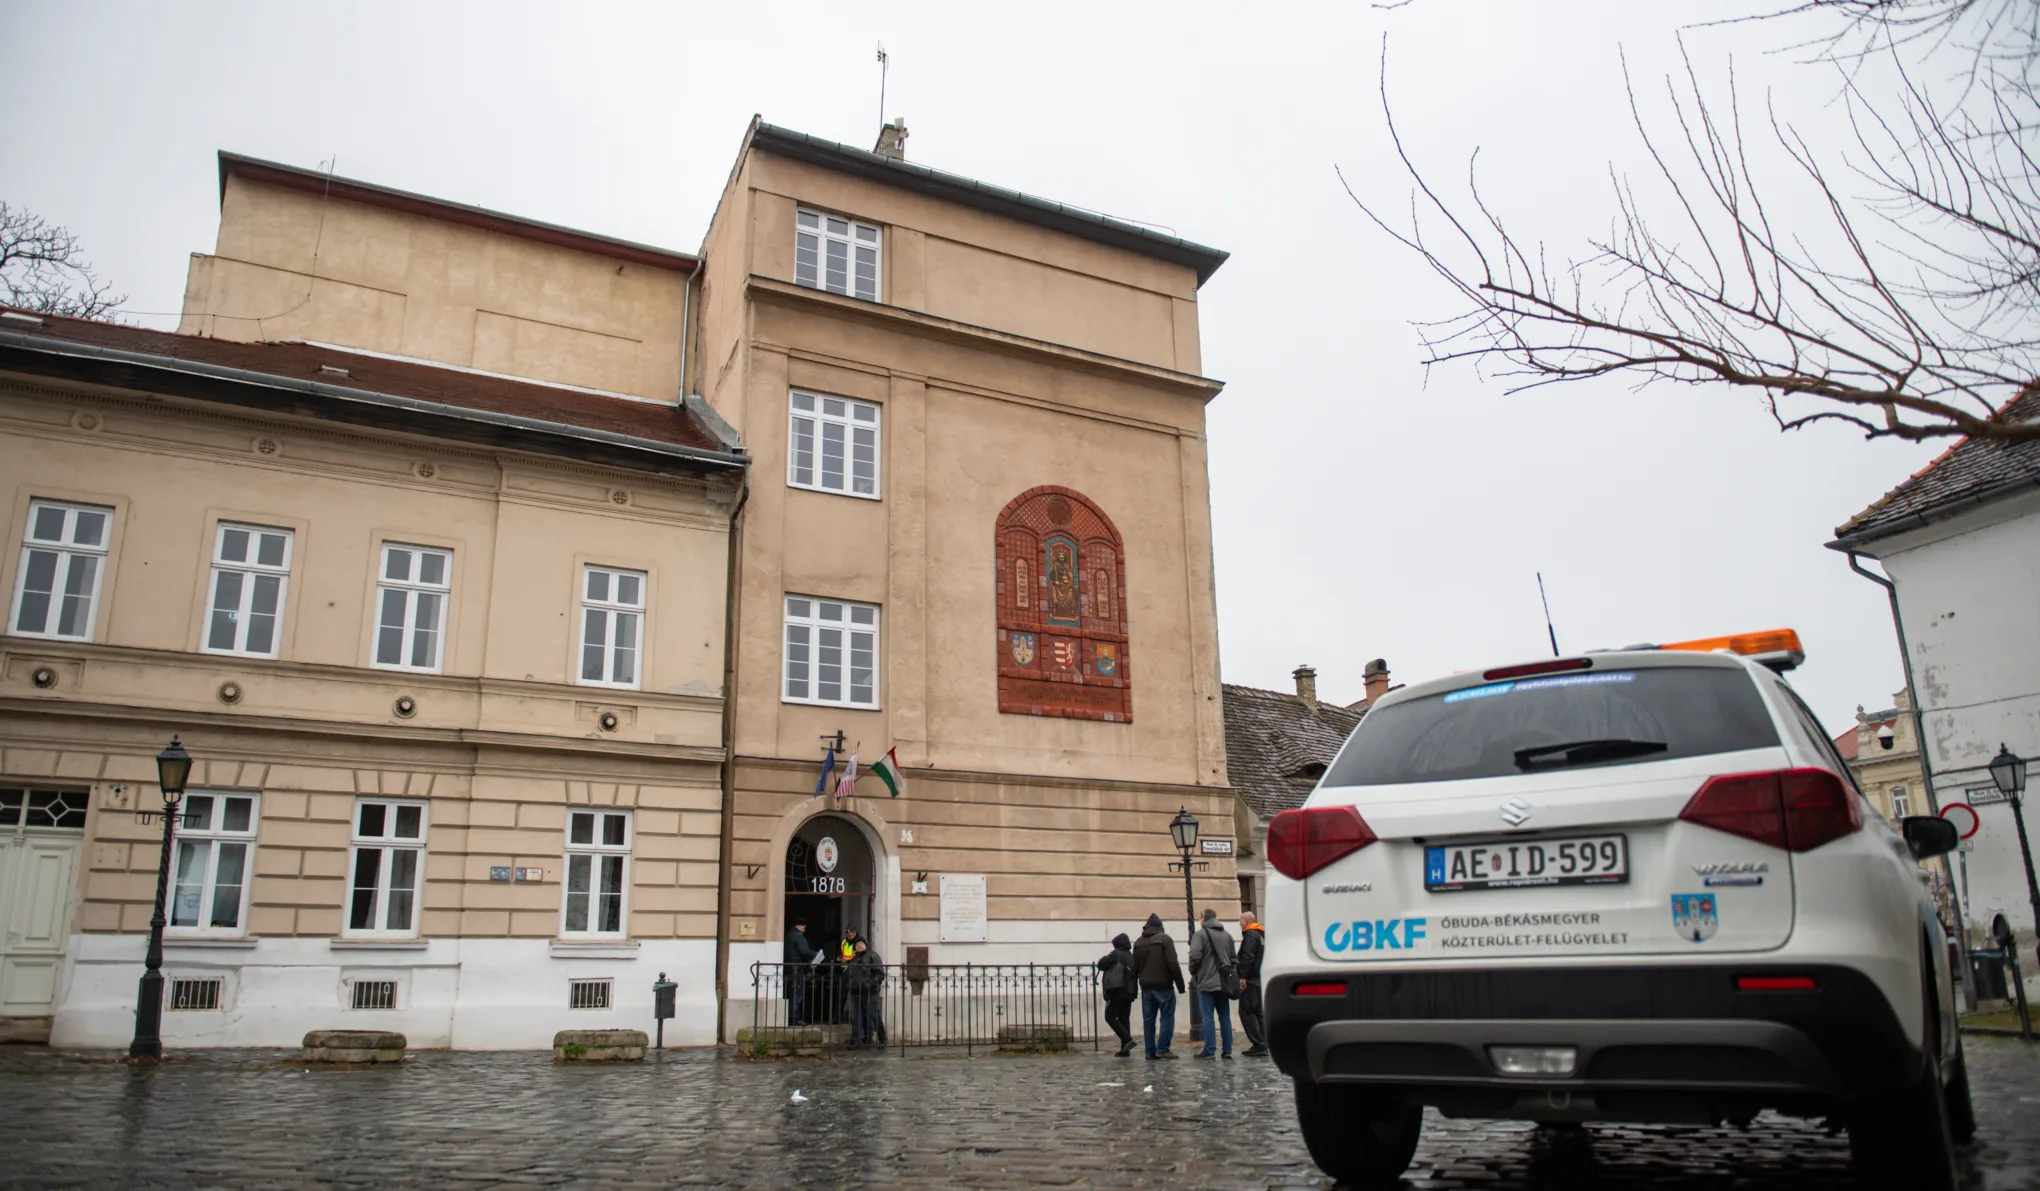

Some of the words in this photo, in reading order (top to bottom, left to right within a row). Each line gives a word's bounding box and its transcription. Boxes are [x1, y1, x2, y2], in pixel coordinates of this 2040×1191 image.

[1450, 848, 1489, 880] AE
[1507, 840, 1618, 877] ID-599
[1431, 868, 1441, 880] H
[811, 877, 845, 893] 1878
[1441, 912, 1601, 929] ÓBUDA-BÉKÁSMEGYER
[1441, 932, 1630, 948] KÖZTERÜLET-FELÜGYELET
